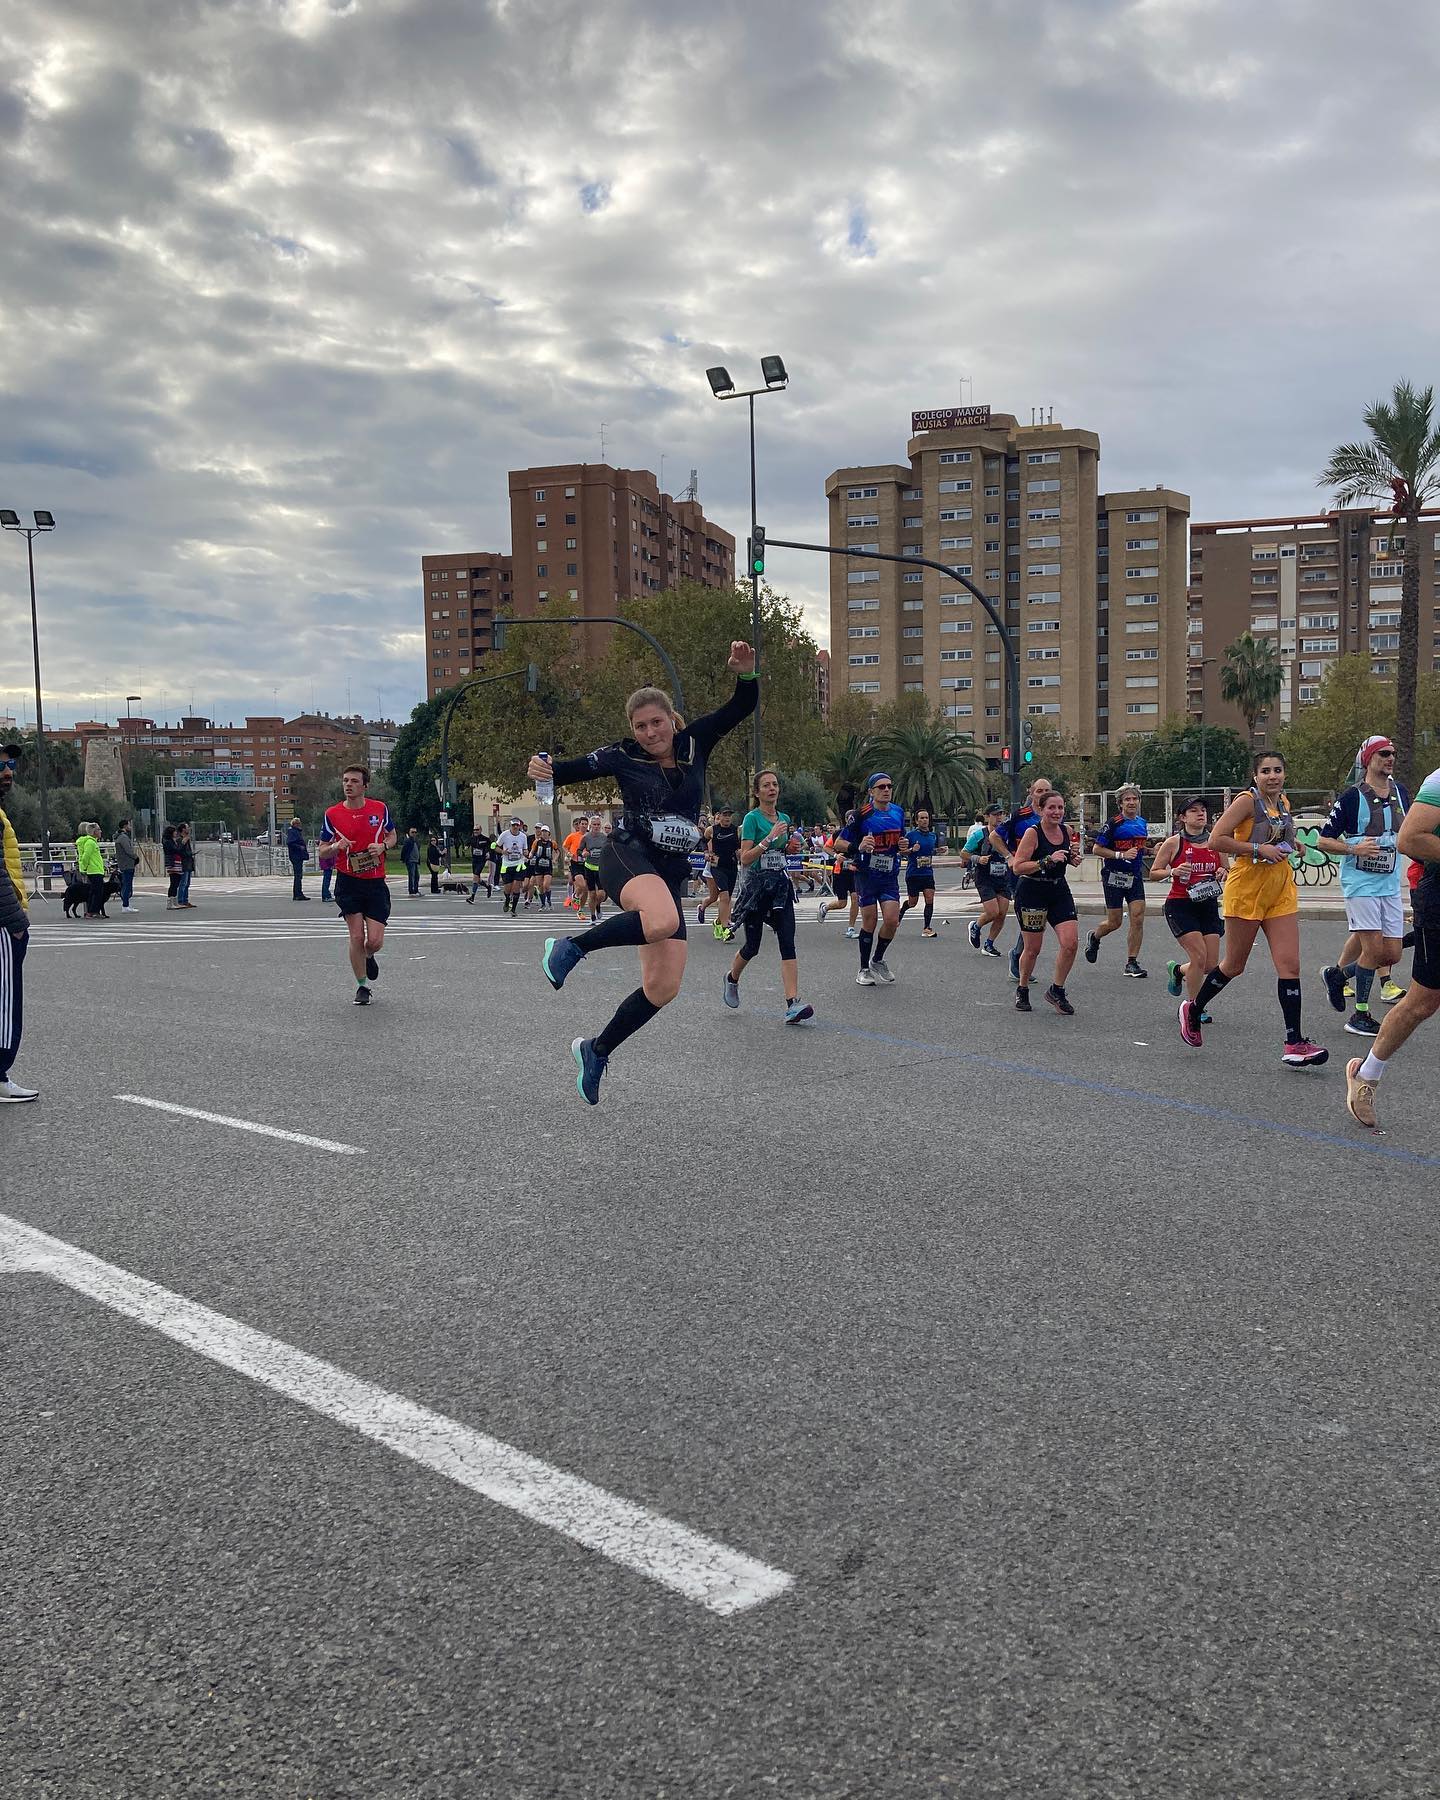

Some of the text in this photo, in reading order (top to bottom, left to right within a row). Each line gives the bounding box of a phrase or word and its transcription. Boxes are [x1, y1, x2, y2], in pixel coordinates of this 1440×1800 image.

[913, 406, 988, 421] COLEGIO MAYOR
[916, 415, 986, 430] AUSIAS MARCH
[664, 825, 690, 836] 27413
[1191, 862, 1204, 872] OSTA
[1363, 861, 1390, 869] Stefano
